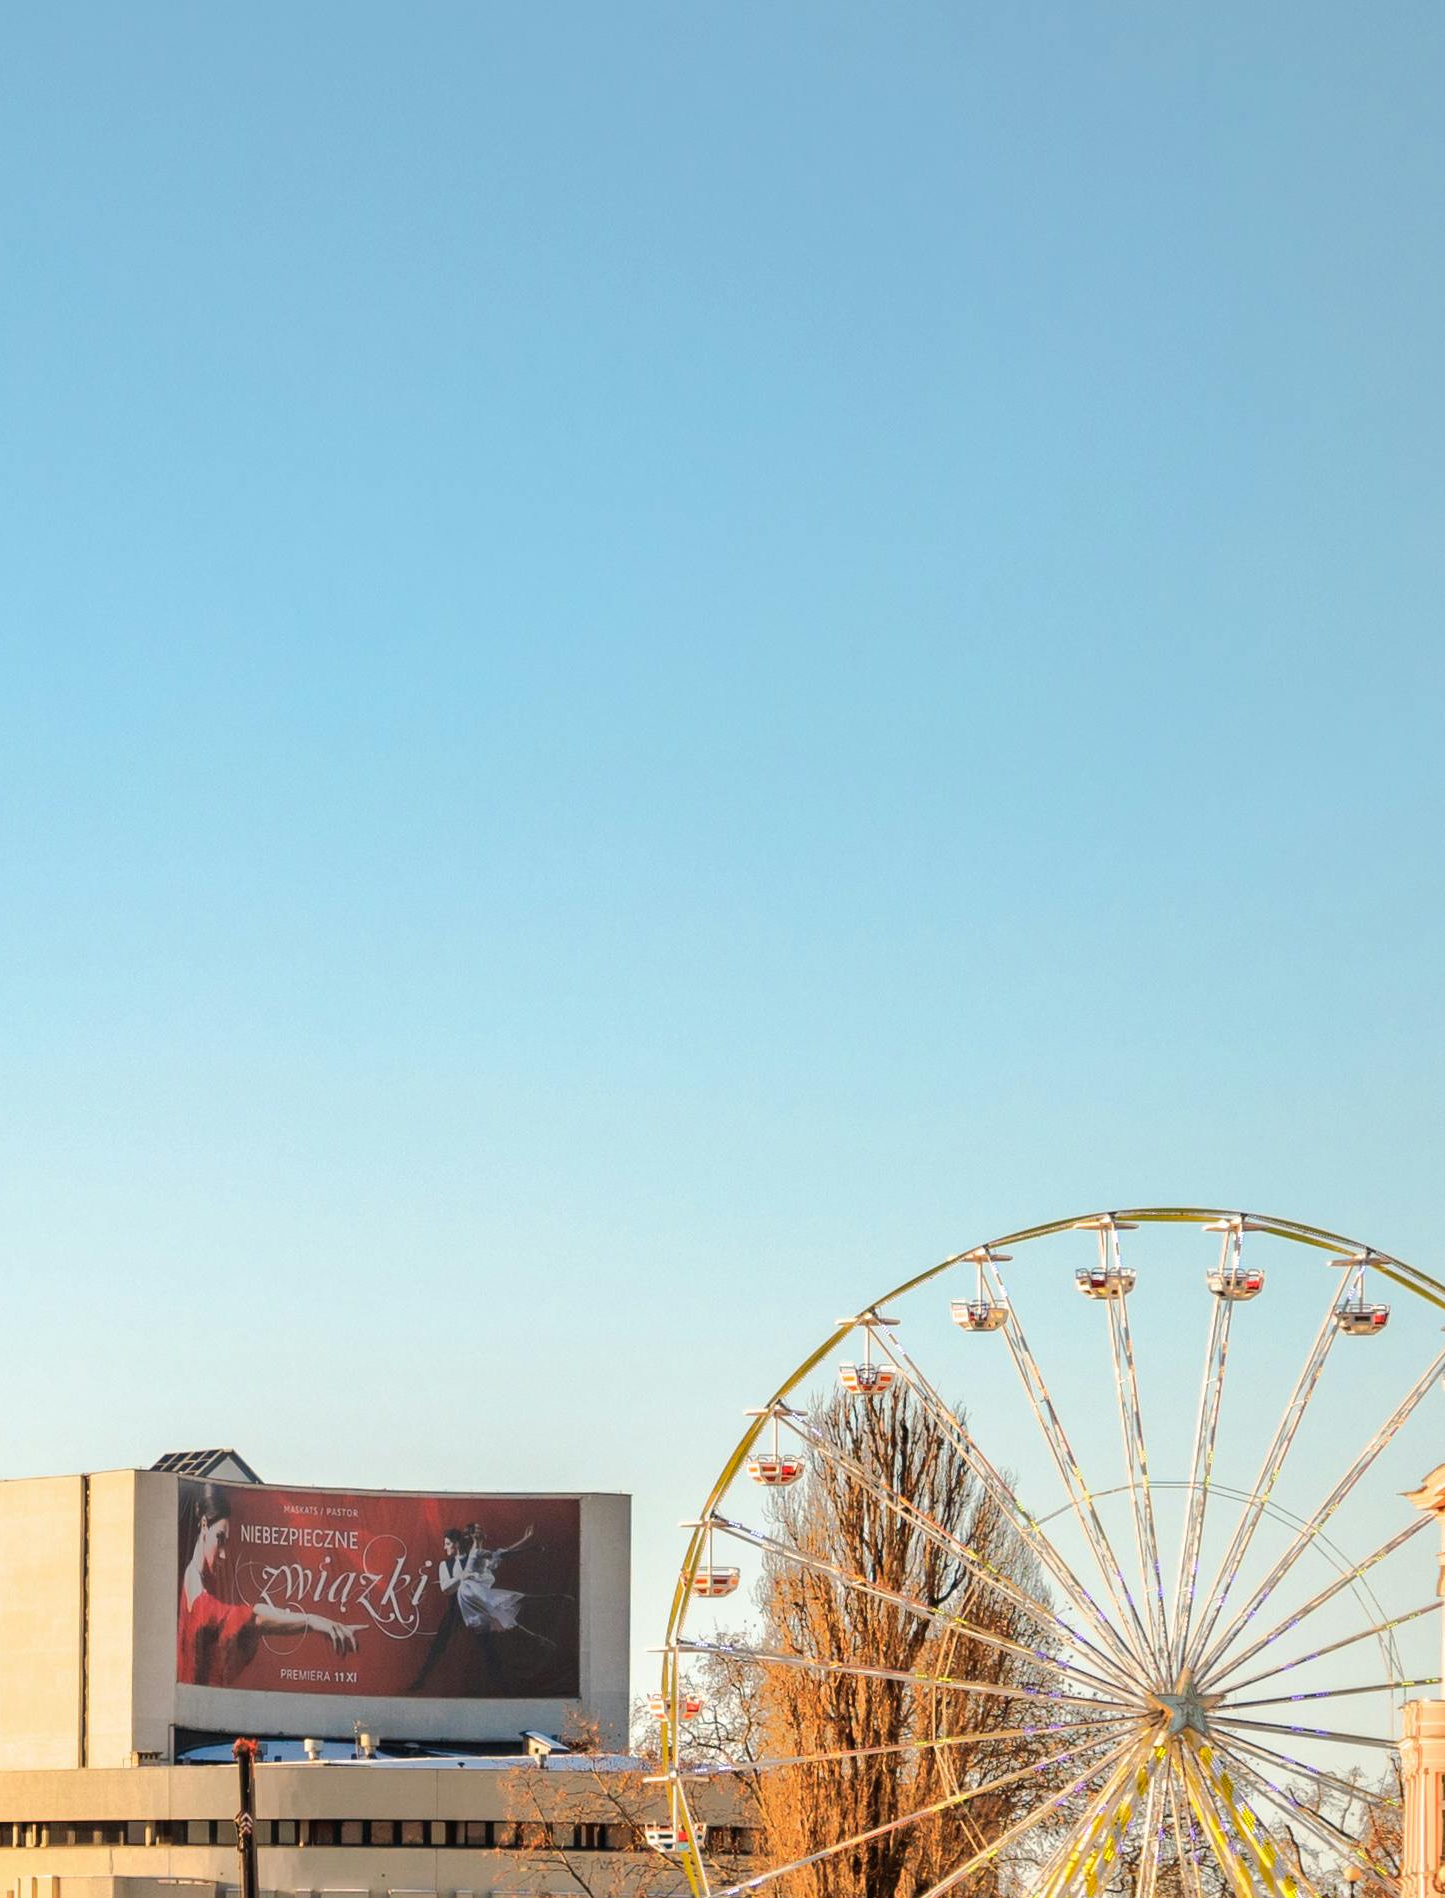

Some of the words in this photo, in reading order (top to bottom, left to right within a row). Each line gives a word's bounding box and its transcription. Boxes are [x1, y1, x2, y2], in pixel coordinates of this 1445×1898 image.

[326, 1507, 359, 1518] PASTOR
[240, 1524, 359, 1550] NIEBEZPIECZNE
[259, 1553, 433, 1628] związki
[280, 1668, 330, 1681] PREMIERA
